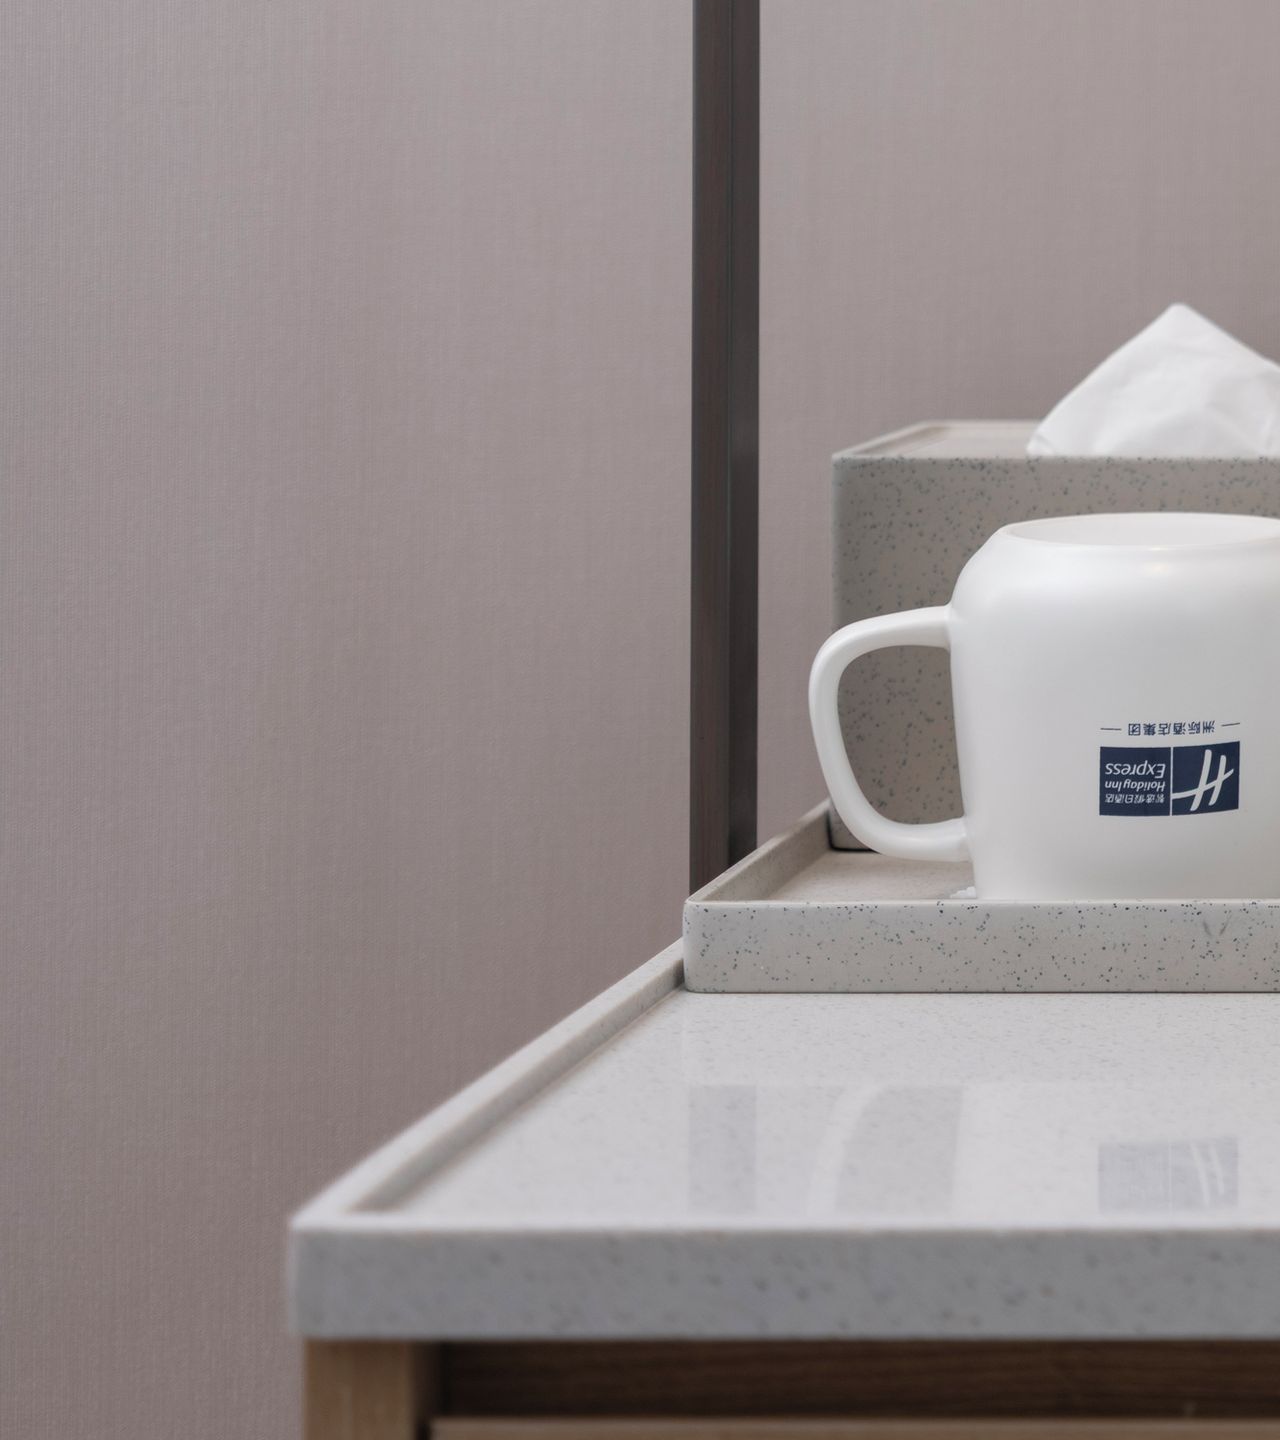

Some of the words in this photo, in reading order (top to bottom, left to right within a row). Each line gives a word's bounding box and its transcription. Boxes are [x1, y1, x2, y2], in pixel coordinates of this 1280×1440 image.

[1128, 720, 1215, 736] 洲际酒店集团
[1105, 760, 1166, 778] Express
[1105, 781, 1122, 791] Inn
[1123, 779, 1165, 791] Holiday
